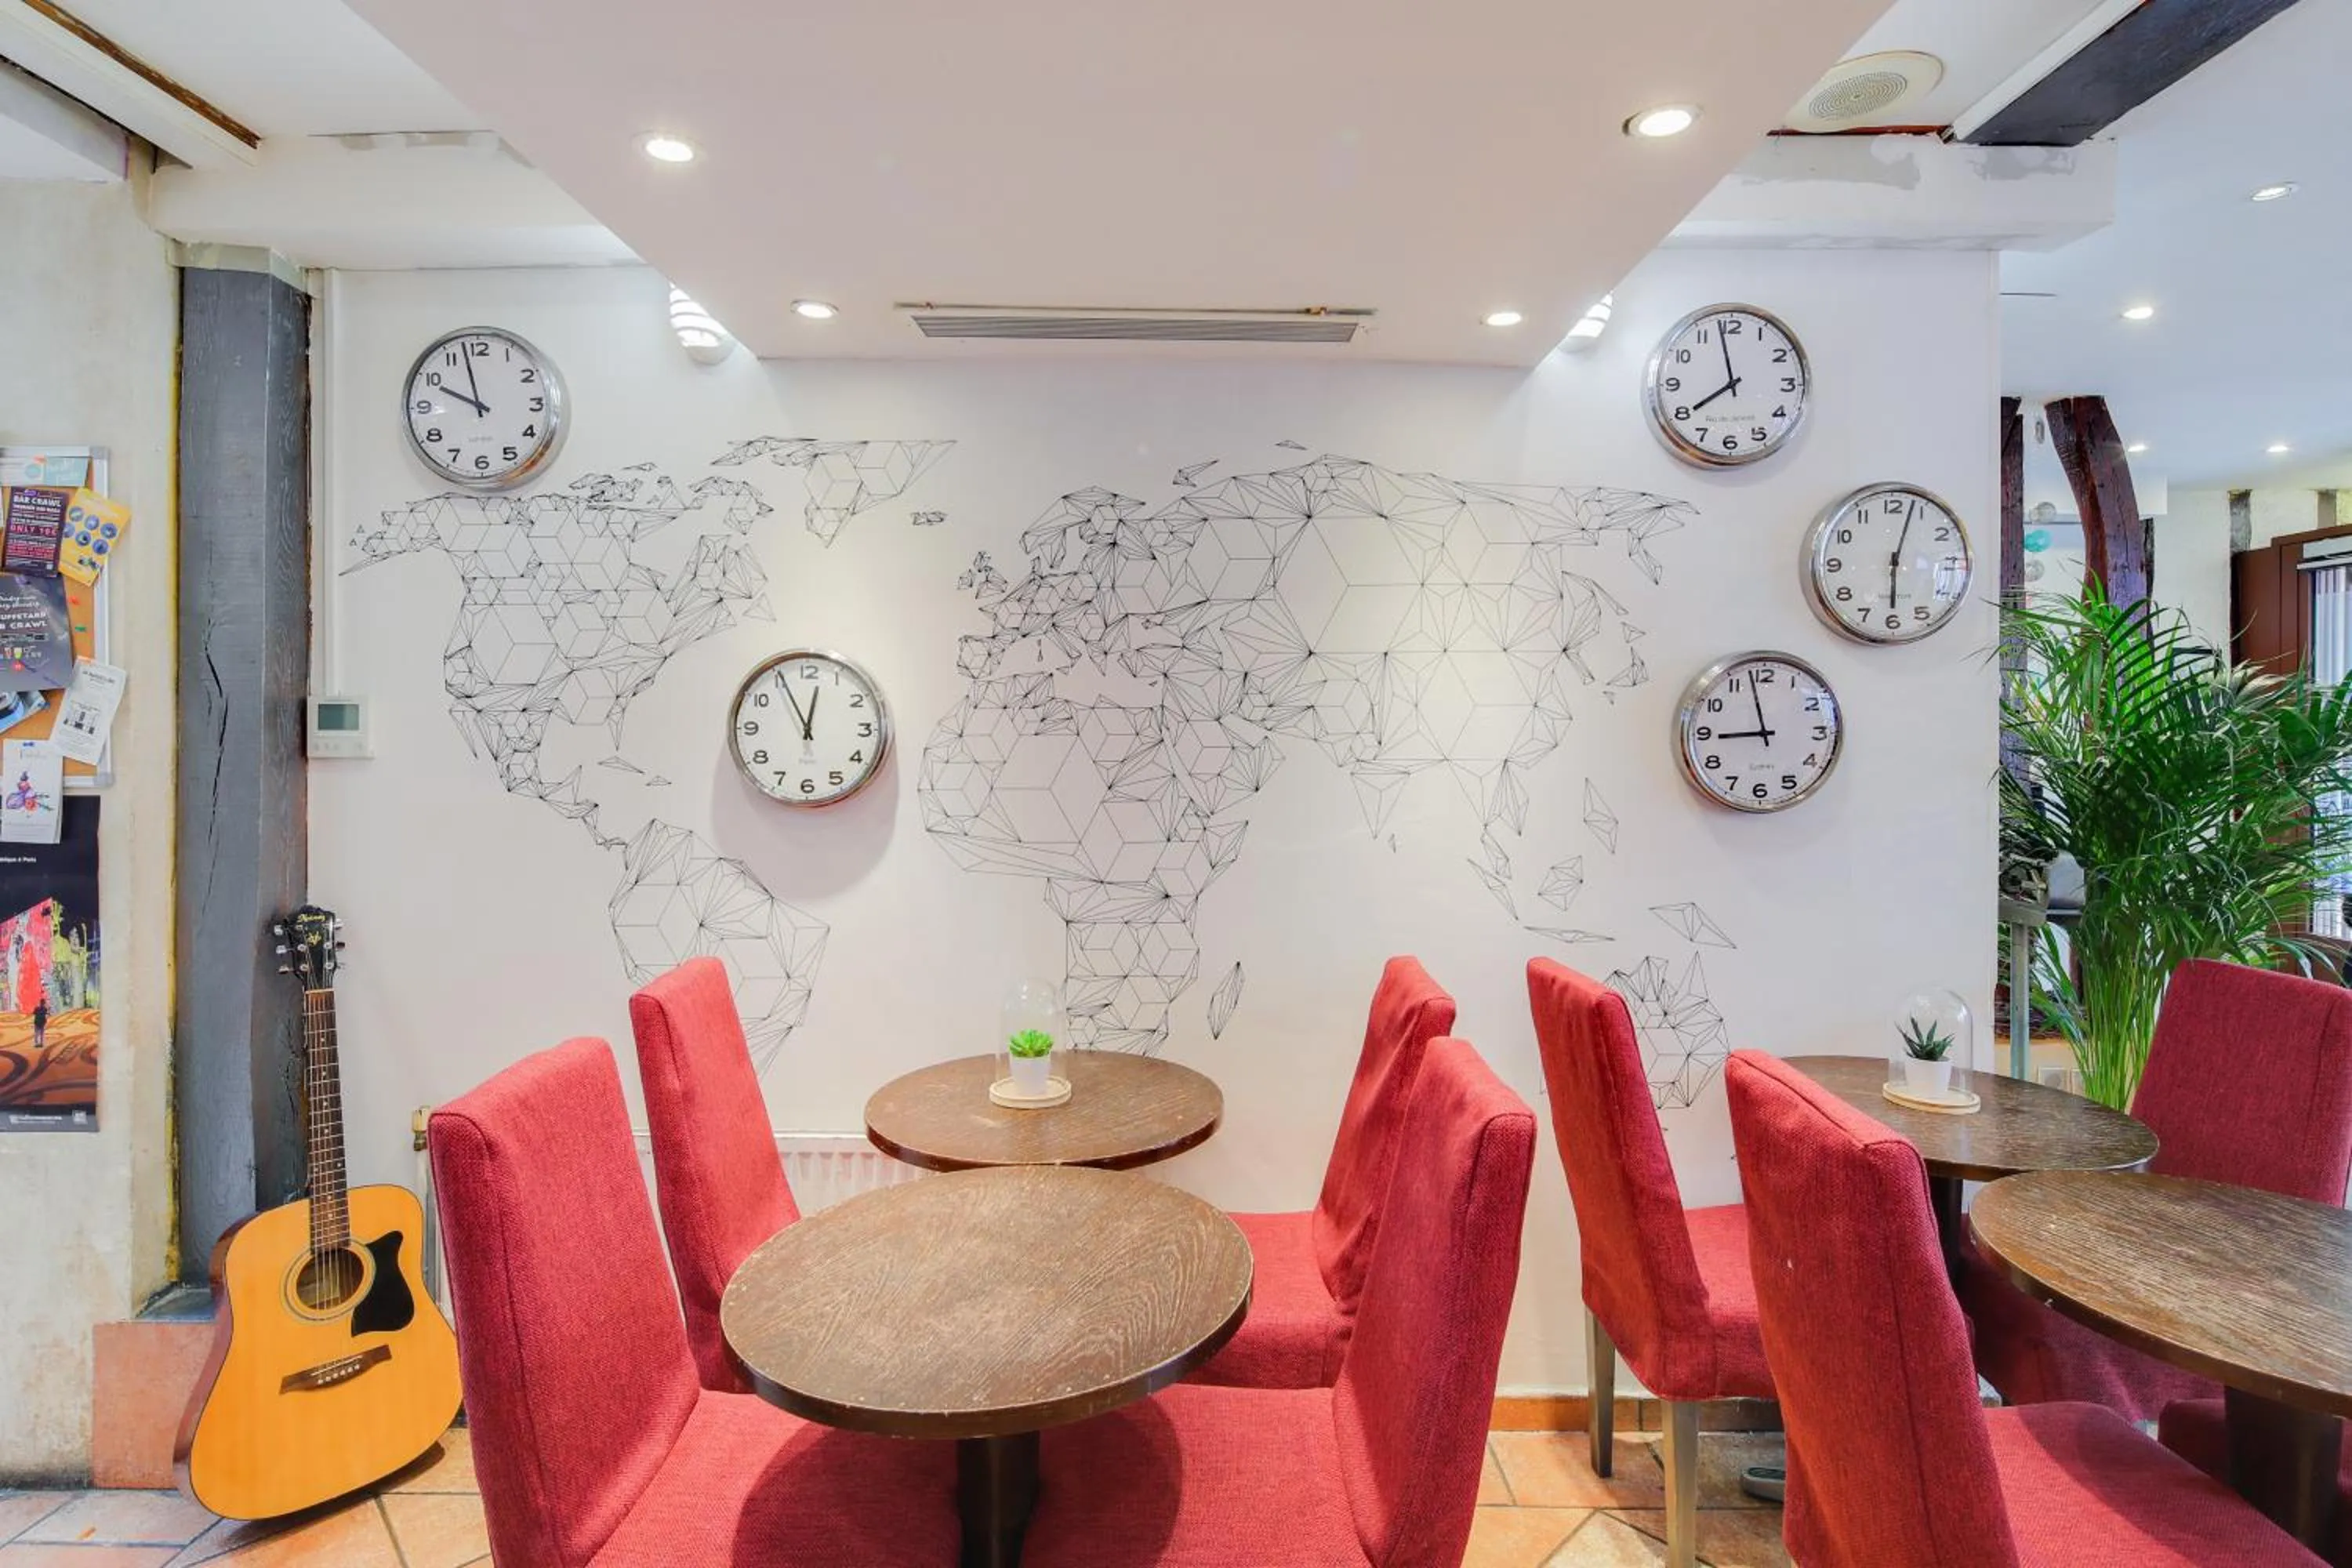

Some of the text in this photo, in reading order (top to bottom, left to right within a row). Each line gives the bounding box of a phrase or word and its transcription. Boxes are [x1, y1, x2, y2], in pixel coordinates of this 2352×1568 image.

[1722, 320, 1741, 334] 12
[1759, 327, 1762, 341] 1
[1697, 329, 1708, 343] 11
[470, 343, 489, 357] 12
[506, 348, 510, 362] 1
[1675, 350, 1691, 363] 10
[1772, 349, 1787, 362] 2
[446, 352, 456, 366] 11
[426, 372, 441, 387] 10
[521, 369, 535, 383] 2
[1665, 377, 1680, 391] 9
[1780, 378, 1795, 392] 3
[416, 400, 431, 414] 9
[529, 397, 543, 412] 3
[1772, 405, 1786, 418] 4
[1675, 406, 1690, 420] 8
[426, 428, 442, 442] 8
[522, 424, 535, 438] 4
[1696, 428, 1708, 442] 7
[1751, 427, 1766, 441] 5
[1722, 435, 1737, 449] 6
[448, 448, 460, 463] 7
[503, 446, 517, 461] 5
[474, 456, 489, 470] 6
[13, 495, 61, 507] BAR CRAWL
[1884, 499, 1902, 514] 12
[1857, 510, 1868, 524] 11
[1920, 506, 1923, 520] 1
[11, 524, 35, 533] ONLY
[1934, 528, 1948, 541] 2
[1837, 529, 1853, 543] 10
[1827, 557, 1842, 572] 9
[1836, 586, 1852, 601] 8
[1857, 608, 1871, 622] 7
[1914, 606, 1929, 620] 5
[9, 620, 47, 630] CRAWL
[1886, 615, 1900, 629] 6
[800, 665, 818, 679] 12
[835, 671, 839, 685] 1
[1755, 669, 1774, 683] 12
[1729, 679, 1739, 692] 11
[1791, 675, 1795, 688] 1
[754, 694, 769, 707] 10
[850, 694, 863, 707] 2
[1708, 699, 1722, 712] 10
[1805, 698, 1819, 711] 2
[743, 721, 758, 735] 9
[858, 722, 872, 737] 3
[1697, 727, 1711, 741] 9
[1812, 726, 1827, 740] 3
[753, 750, 768, 764] 8
[849, 750, 862, 764] 4
[1705, 755, 1721, 768] 8
[1803, 753, 1816, 768] 4
[774, 771, 786, 786] 7
[829, 771, 844, 785] 5
[1726, 776, 1738, 790] 7
[1781, 775, 1797, 789] 5
[800, 779, 815, 793] 6
[1752, 784, 1768, 798] 6
